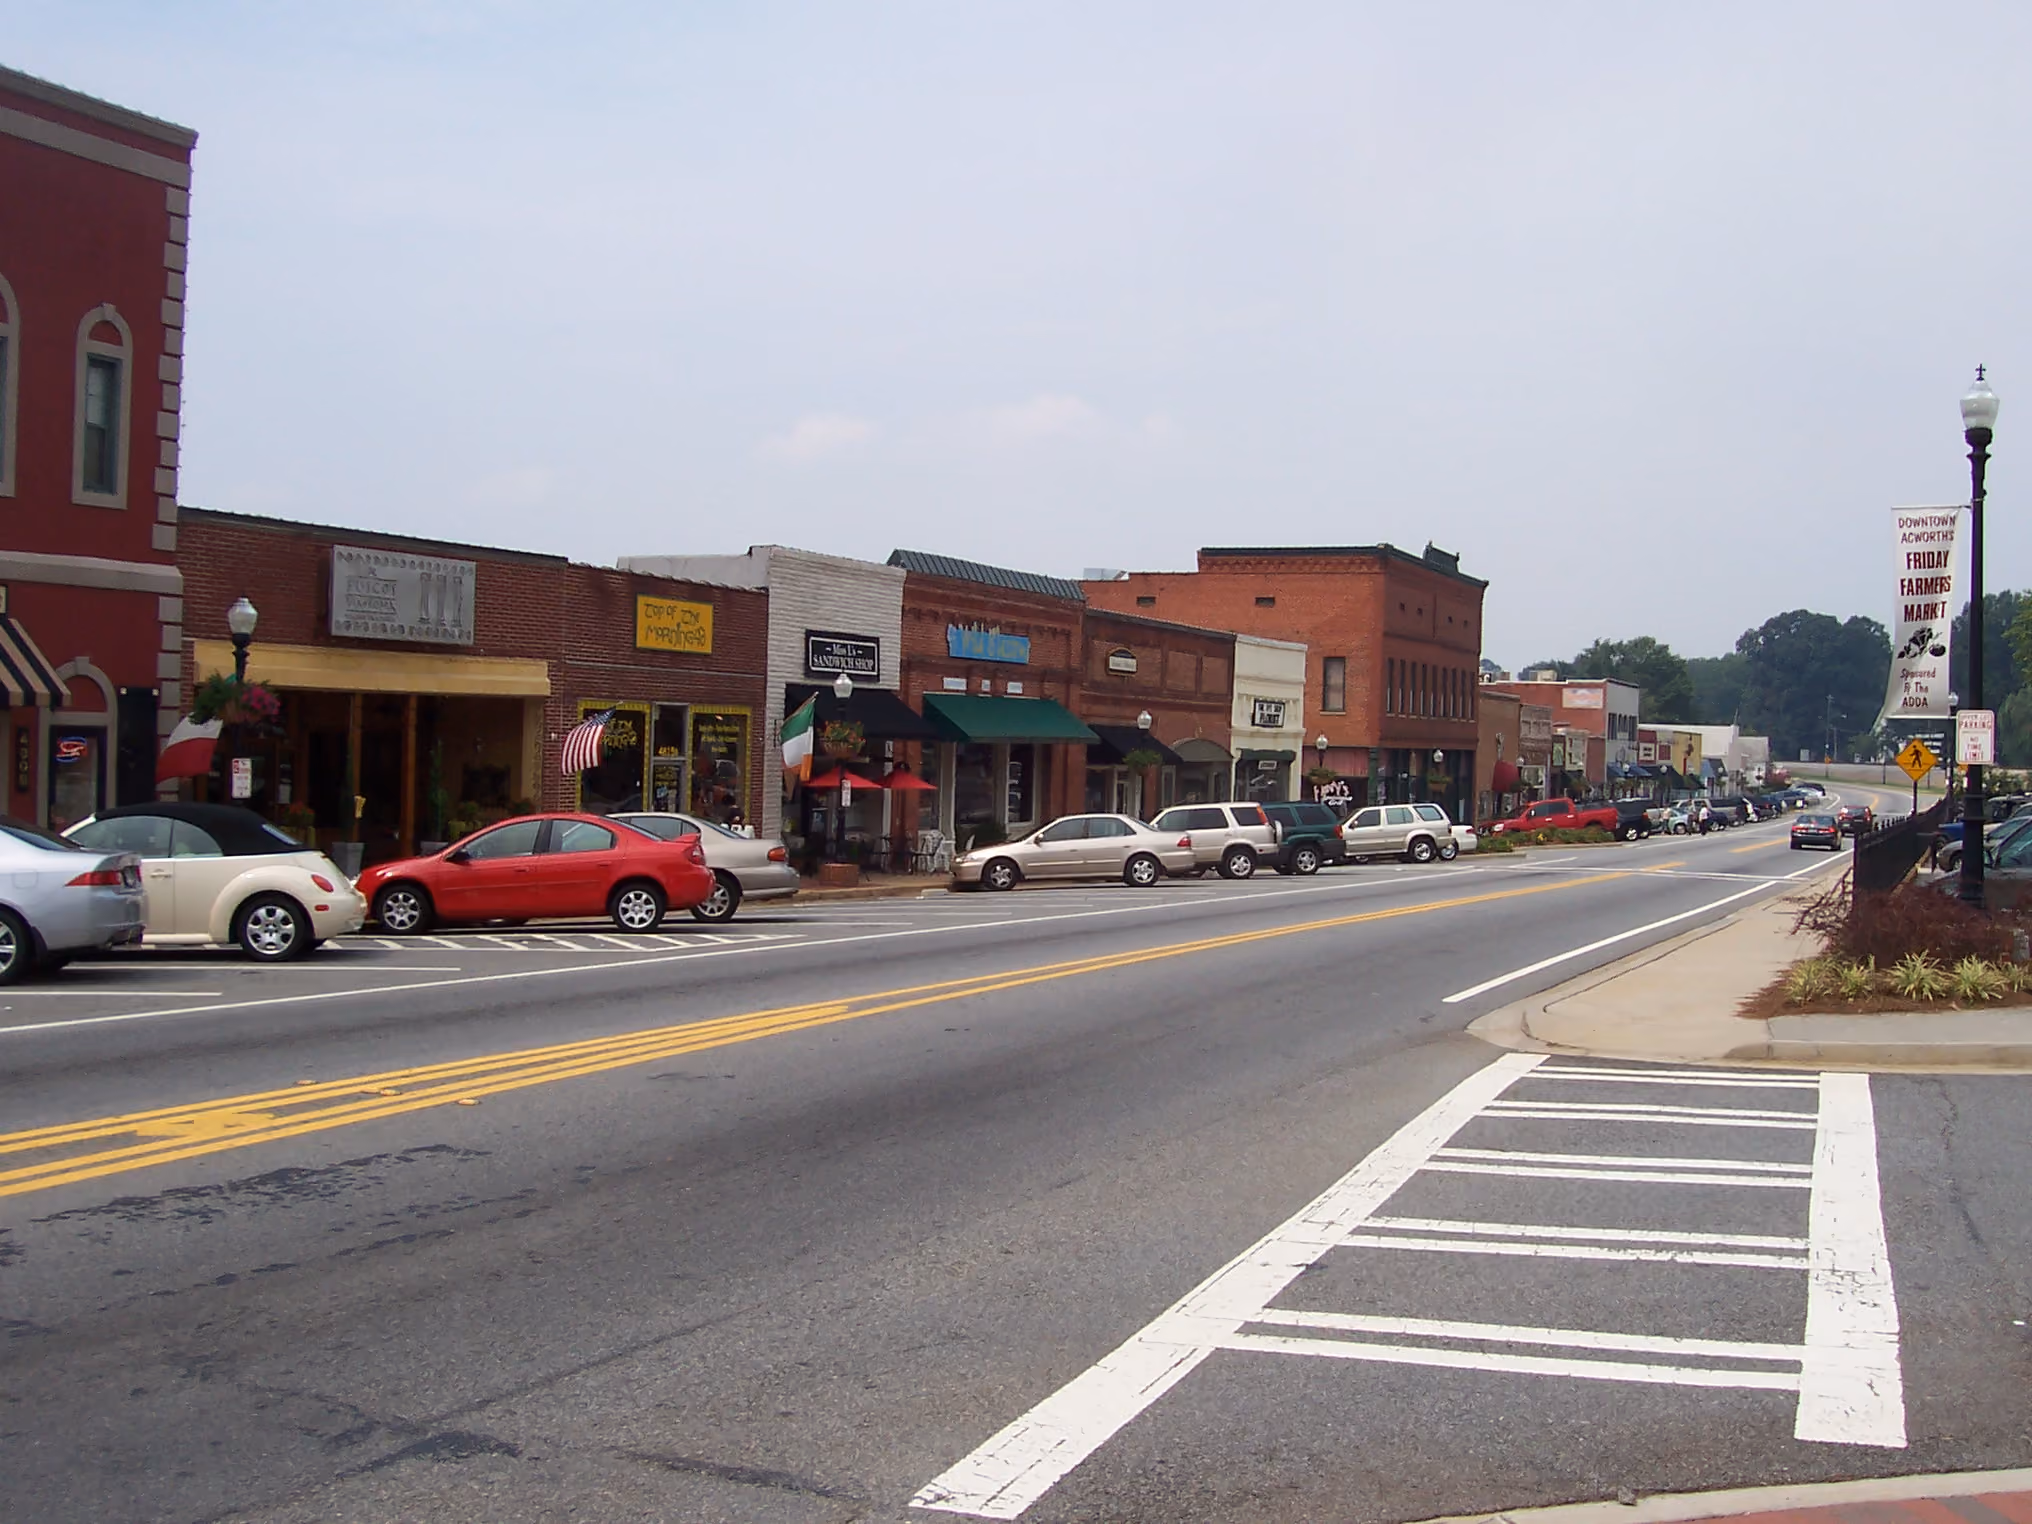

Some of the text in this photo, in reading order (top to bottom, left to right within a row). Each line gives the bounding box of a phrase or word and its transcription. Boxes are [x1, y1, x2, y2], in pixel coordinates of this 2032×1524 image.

[1898, 515, 1956, 529] DOWNTOWN
[1906, 550, 1949, 570] FRIDAY
[1900, 575, 1952, 596] FARMERS
[813, 654, 874, 671] SANDWICH SHOP
[1902, 696, 1929, 708] ADDA
[1958, 720, 1992, 729] PARKING
[1968, 743, 1982, 751] TIME
[1965, 751, 1983, 760] LIMIT
